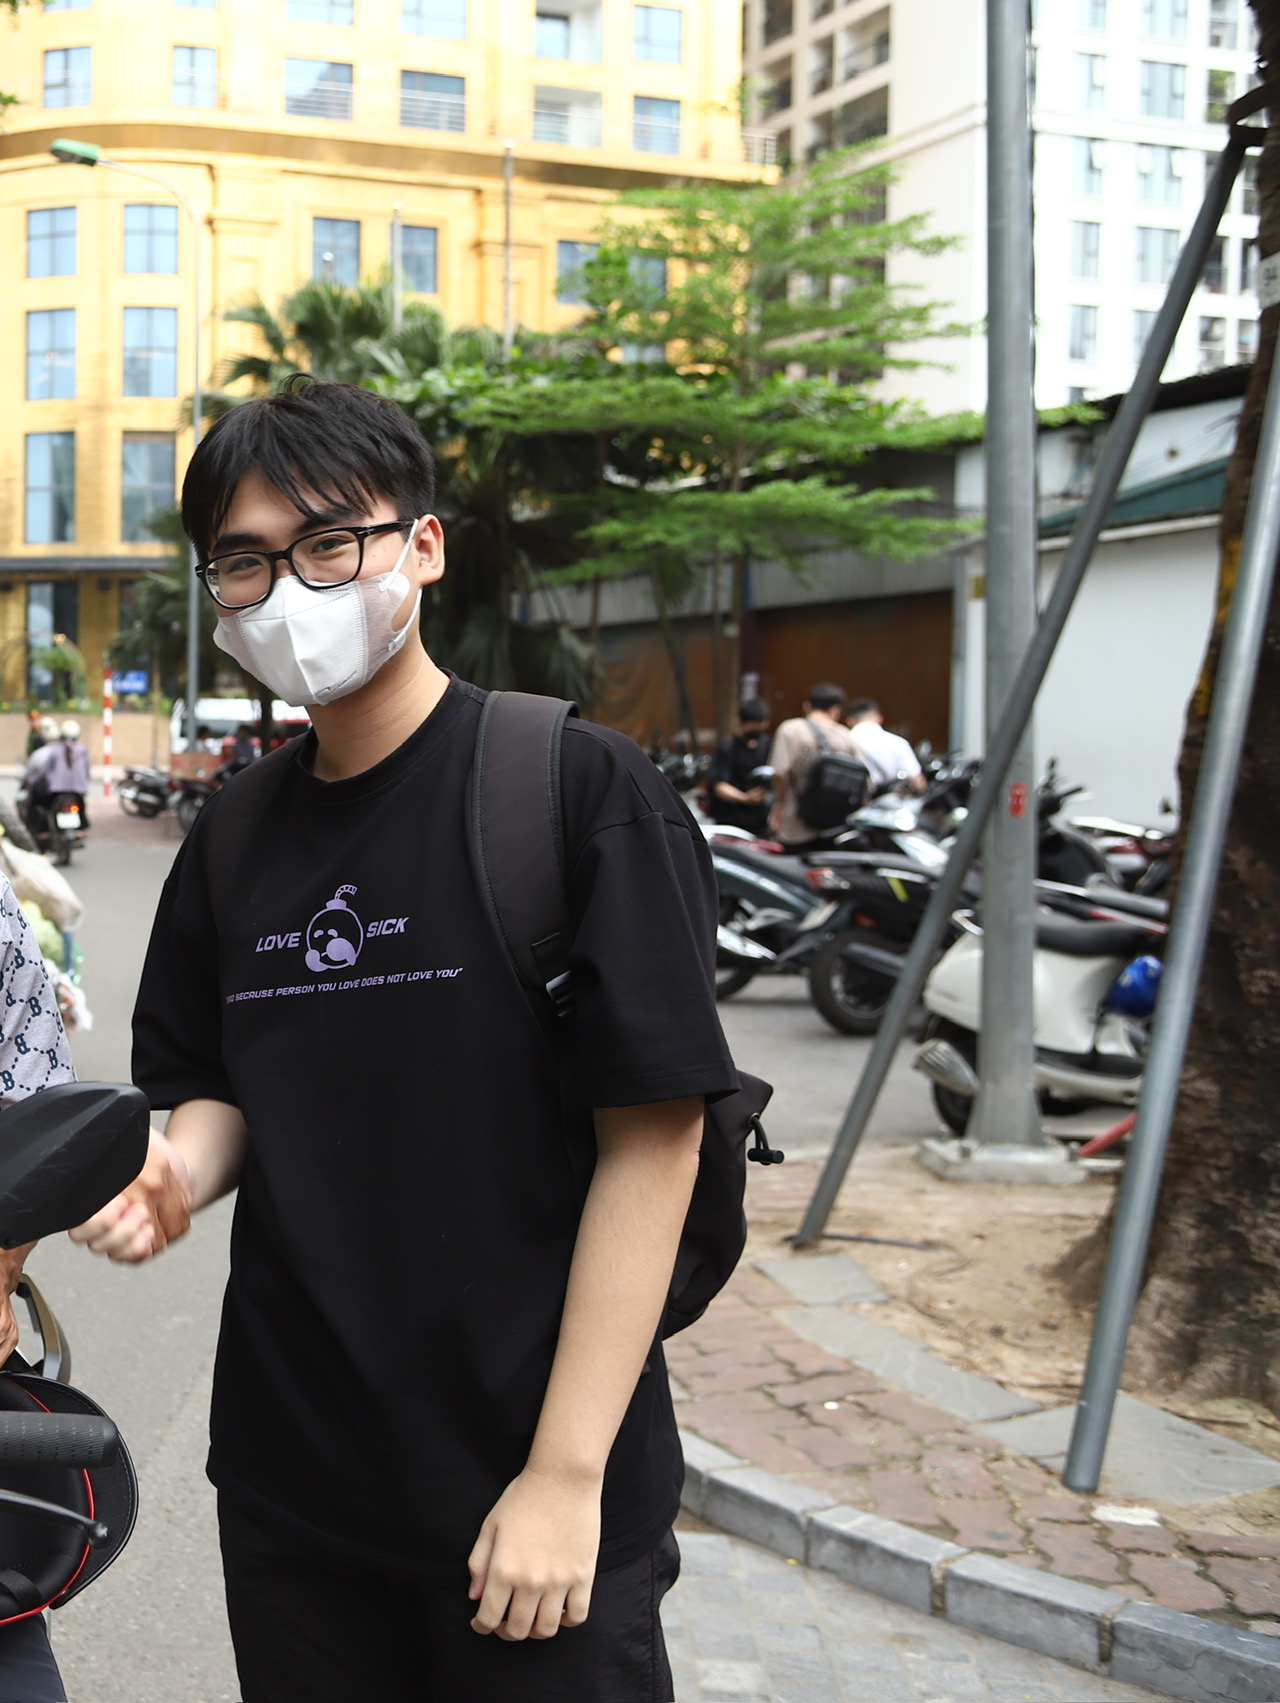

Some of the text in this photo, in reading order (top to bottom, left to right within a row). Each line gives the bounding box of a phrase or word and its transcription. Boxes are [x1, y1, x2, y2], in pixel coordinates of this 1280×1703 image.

[255, 917, 410, 952] LOVE SICK
[235, 989, 275, 1001] BECAUSE
[275, 985, 316, 997] PERSON
[317, 983, 337, 992] YOU
[338, 979, 361, 990] LOVE
[361, 976, 385, 987] DOES
[386, 973, 407, 984] NOT
[407, 971, 434, 982] LOVE
